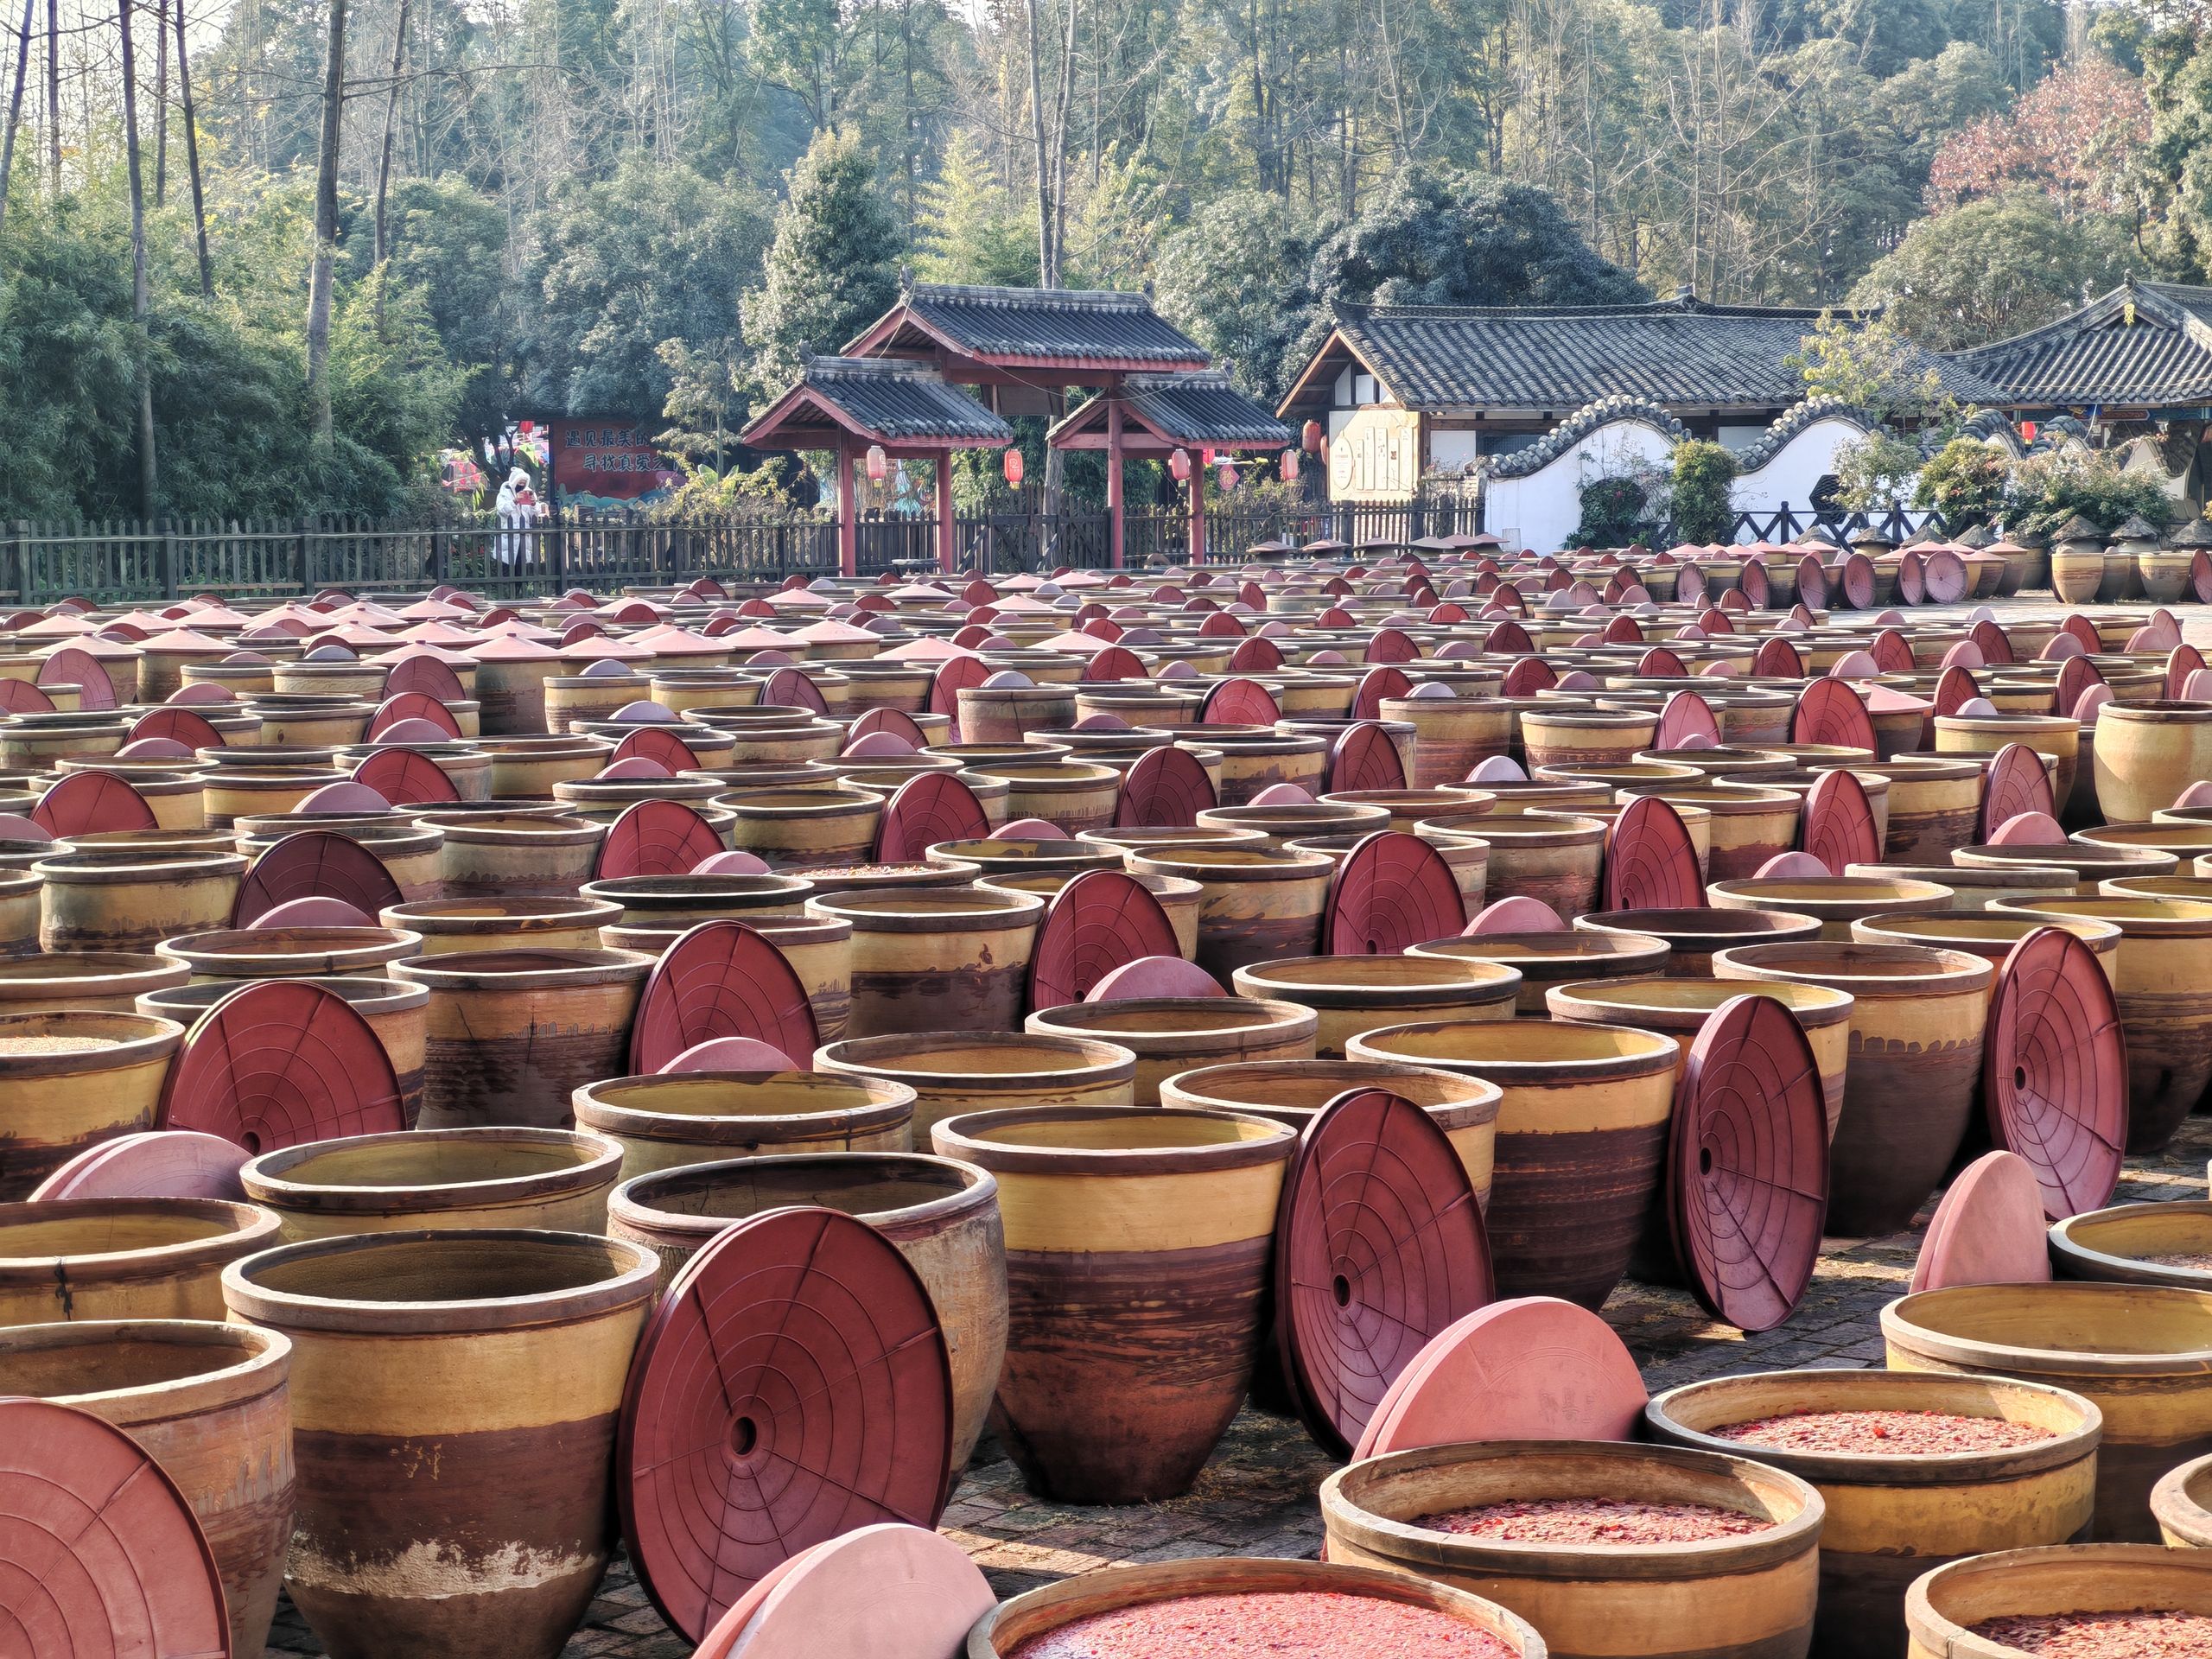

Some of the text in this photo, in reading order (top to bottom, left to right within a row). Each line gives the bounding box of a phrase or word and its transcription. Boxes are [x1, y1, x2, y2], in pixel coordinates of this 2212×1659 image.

[582, 452, 678, 472] 寻找真爱之
